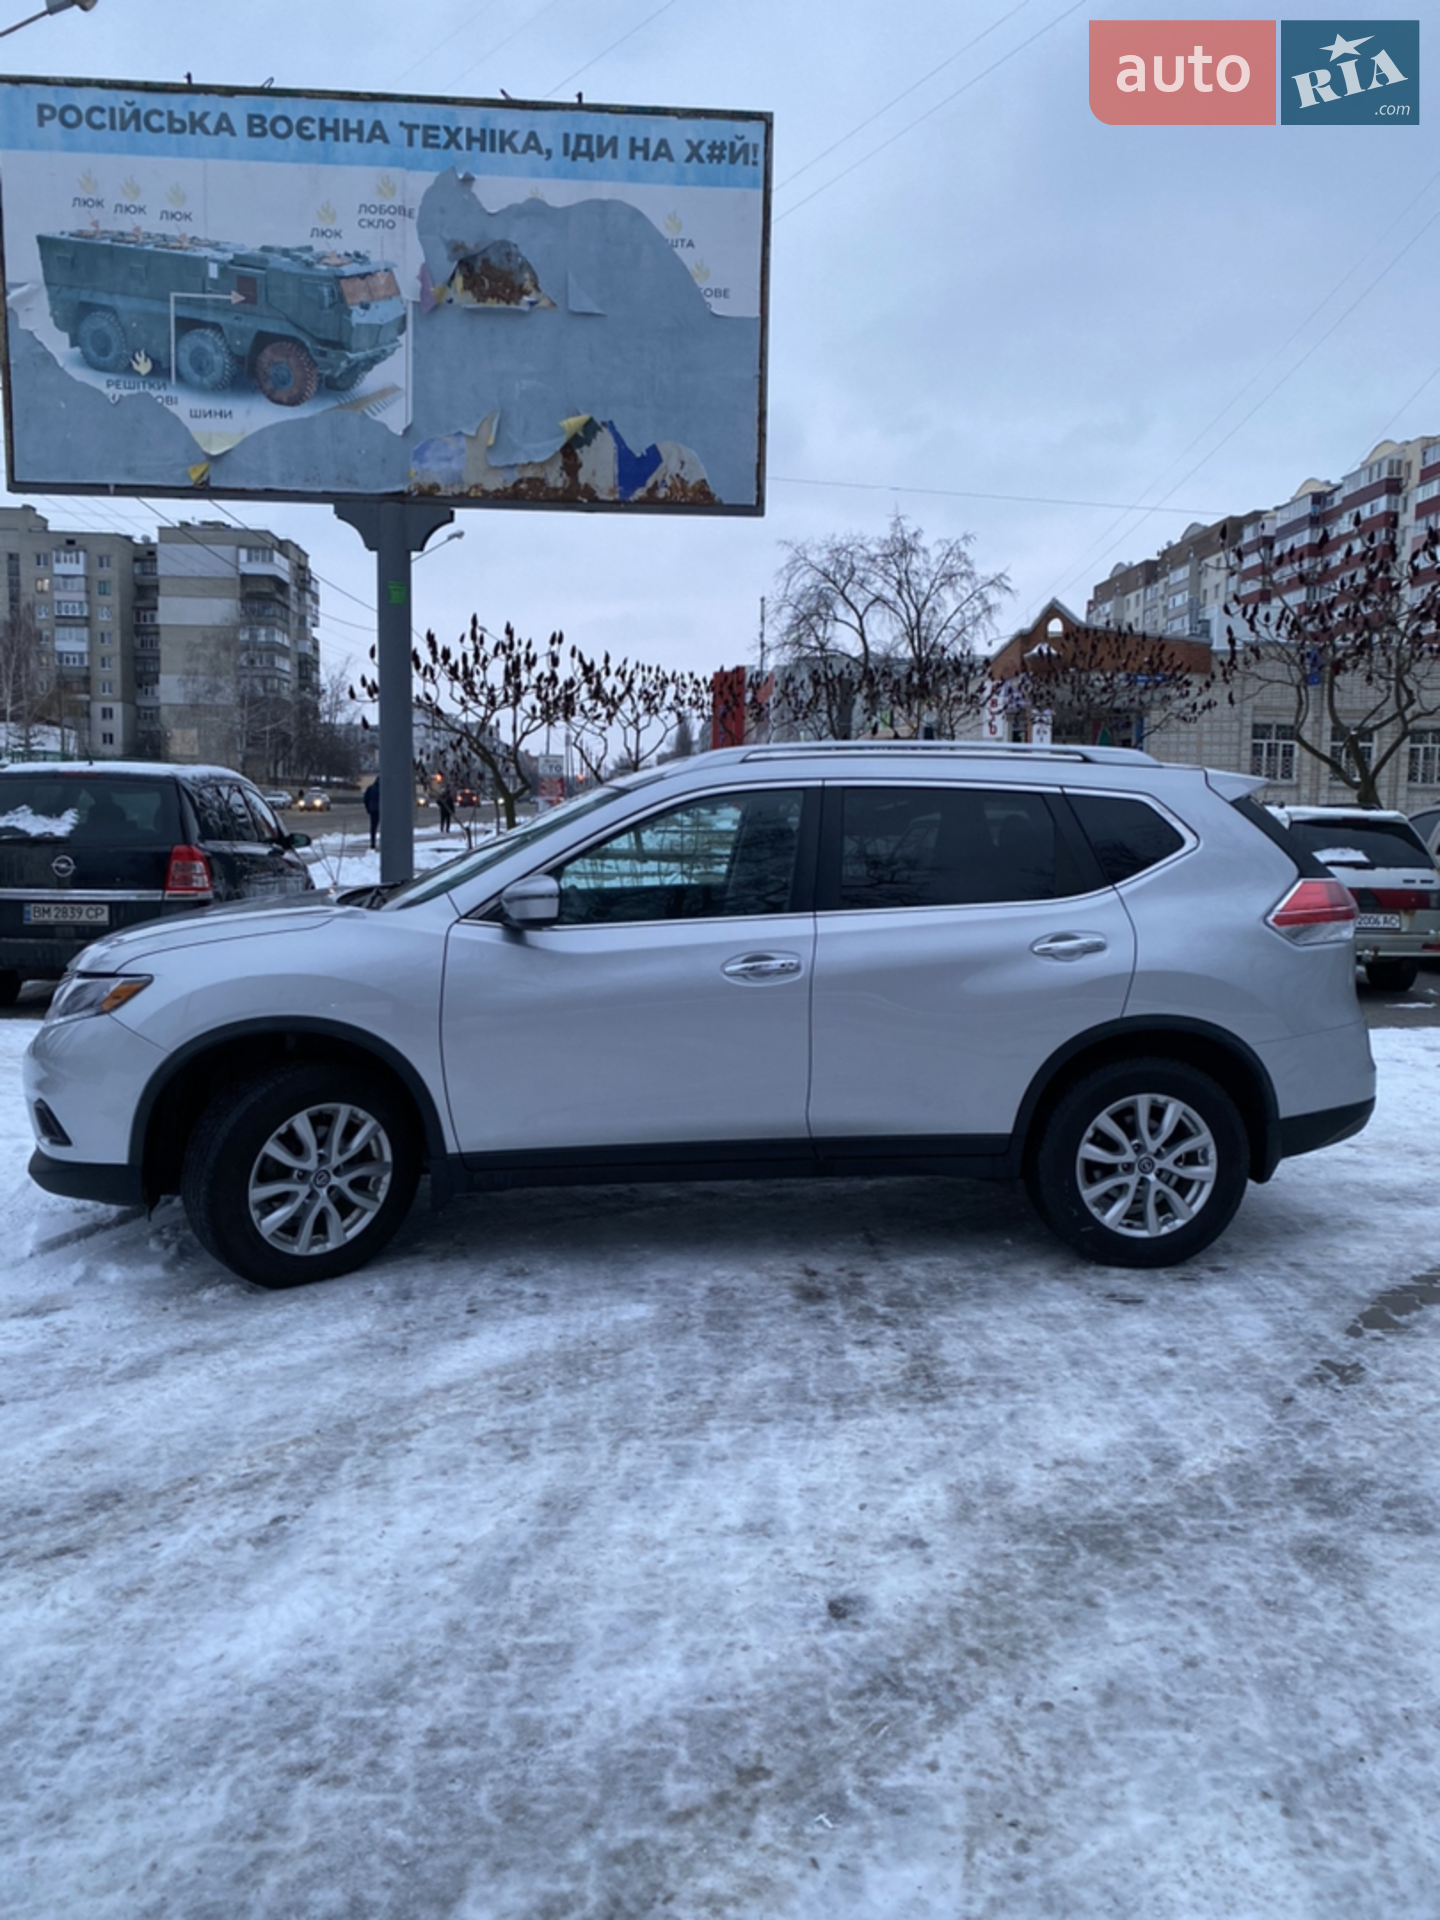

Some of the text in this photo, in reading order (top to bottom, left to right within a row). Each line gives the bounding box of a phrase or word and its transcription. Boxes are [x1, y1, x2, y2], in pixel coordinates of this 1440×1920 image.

[36, 101, 760, 167] РОСІЙСЬКА ВОЄННА ТЕХНІКА, ІДИ НА Х#Й!
[72, 197, 105, 209] ЛЮК
[113, 203, 147, 215] ЛЮК
[159, 210, 193, 222] ЛЮК
[357, 218, 396, 230] СКЛО
[309, 227, 343, 239] ЛЮК
[700, 287, 731, 299] ОВЕ
[106, 379, 167, 391] РЕШІТКИ
[189, 408, 234, 420] ШИНИ
[33, 906, 105, 919] BM 2839 CP
